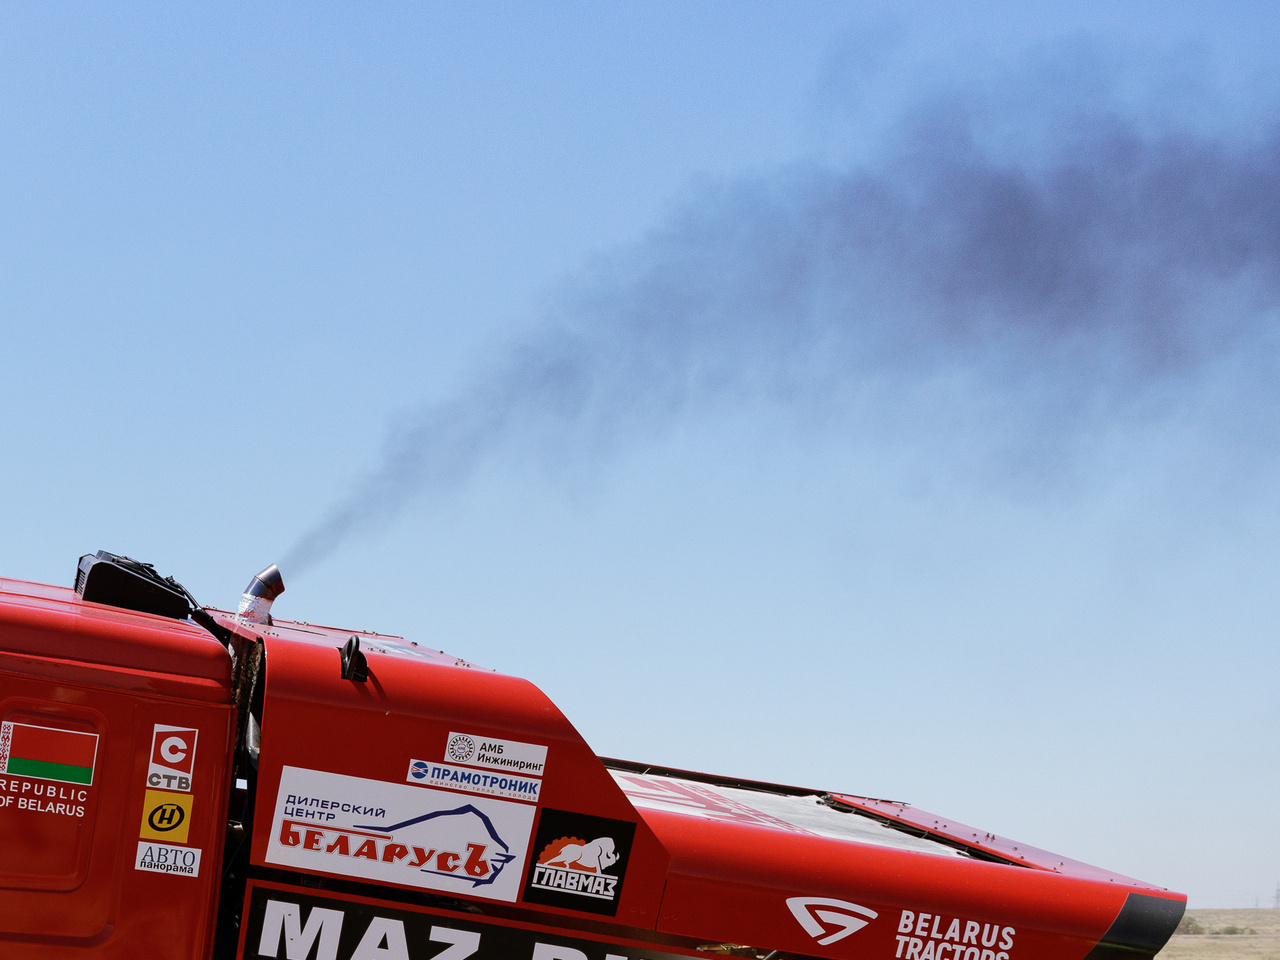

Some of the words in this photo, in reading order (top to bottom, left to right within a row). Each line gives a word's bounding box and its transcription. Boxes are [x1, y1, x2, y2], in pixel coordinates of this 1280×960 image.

[479, 742, 504, 754] АМБ
[476, 752, 544, 772] Инжиниринг
[429, 780, 468, 790] единство
[508, 792, 537, 801] холода
[430, 766, 539, 795] ПРАМОТРОНИК
[18, 798, 85, 818] BELARUS
[284, 806, 336, 822] ЦЕНТР
[286, 794, 386, 818] ДИЛЕРСКИЙ
[141, 846, 196, 867] АВТО
[140, 860, 194, 875] панорама
[532, 867, 618, 896] ГЛАВМАЗ
[897, 910, 1016, 950] BELARUS
